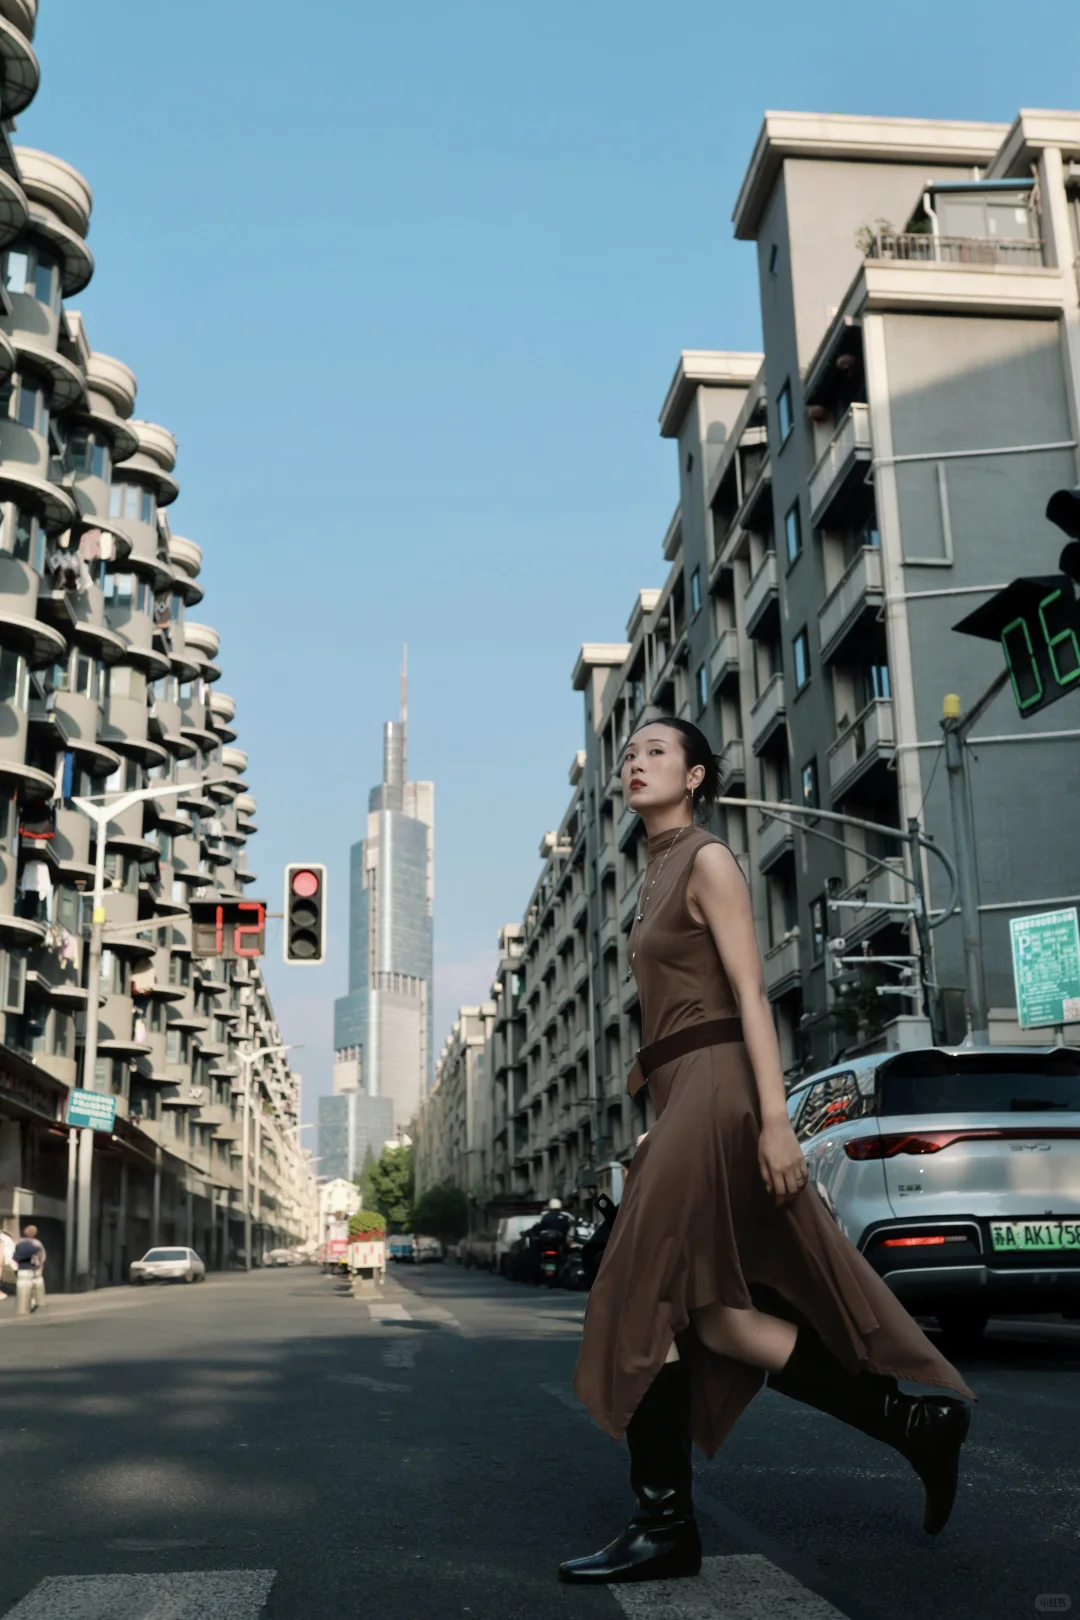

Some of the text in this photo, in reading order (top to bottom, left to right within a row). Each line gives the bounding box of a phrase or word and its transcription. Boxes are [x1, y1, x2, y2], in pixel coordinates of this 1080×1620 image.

[1001, 588, 1080, 709] 06
[215, 902, 265, 957] 12
[1018, 936, 1031, 956] P
